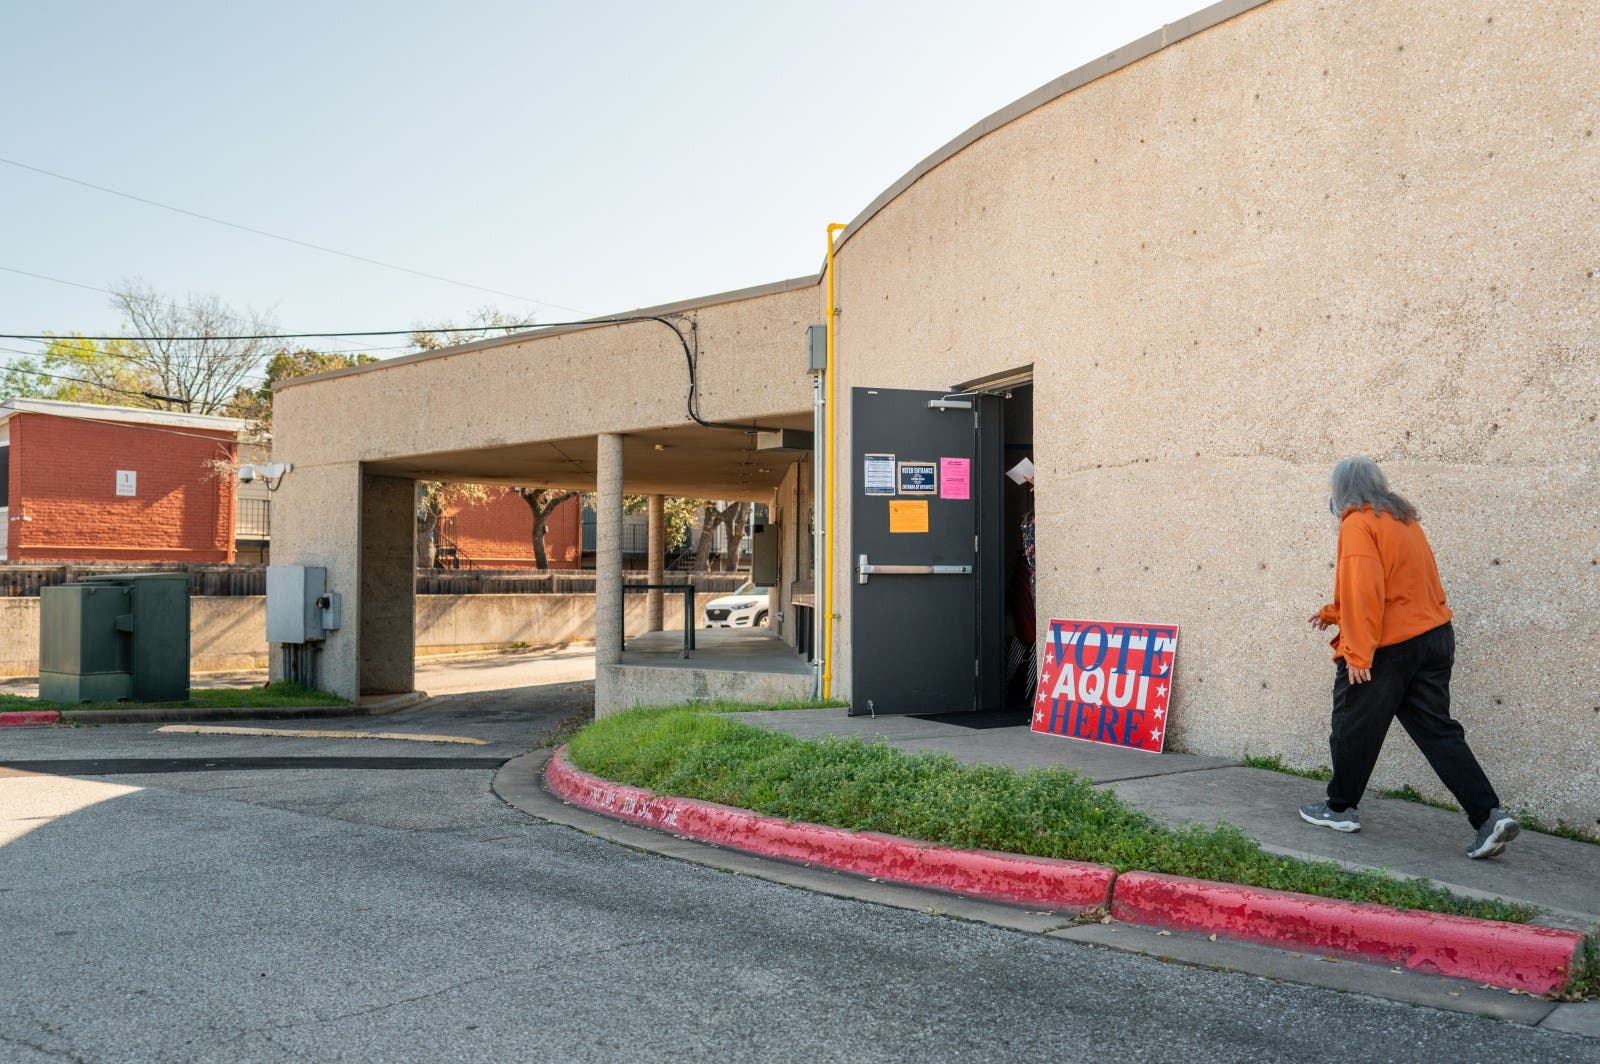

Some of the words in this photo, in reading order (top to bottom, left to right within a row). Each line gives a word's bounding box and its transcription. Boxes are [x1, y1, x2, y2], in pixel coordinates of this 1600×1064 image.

[1051, 624, 1172, 678] VOTE
[1050, 663, 1150, 710] AQUI
[1048, 698, 1144, 746] HERE
